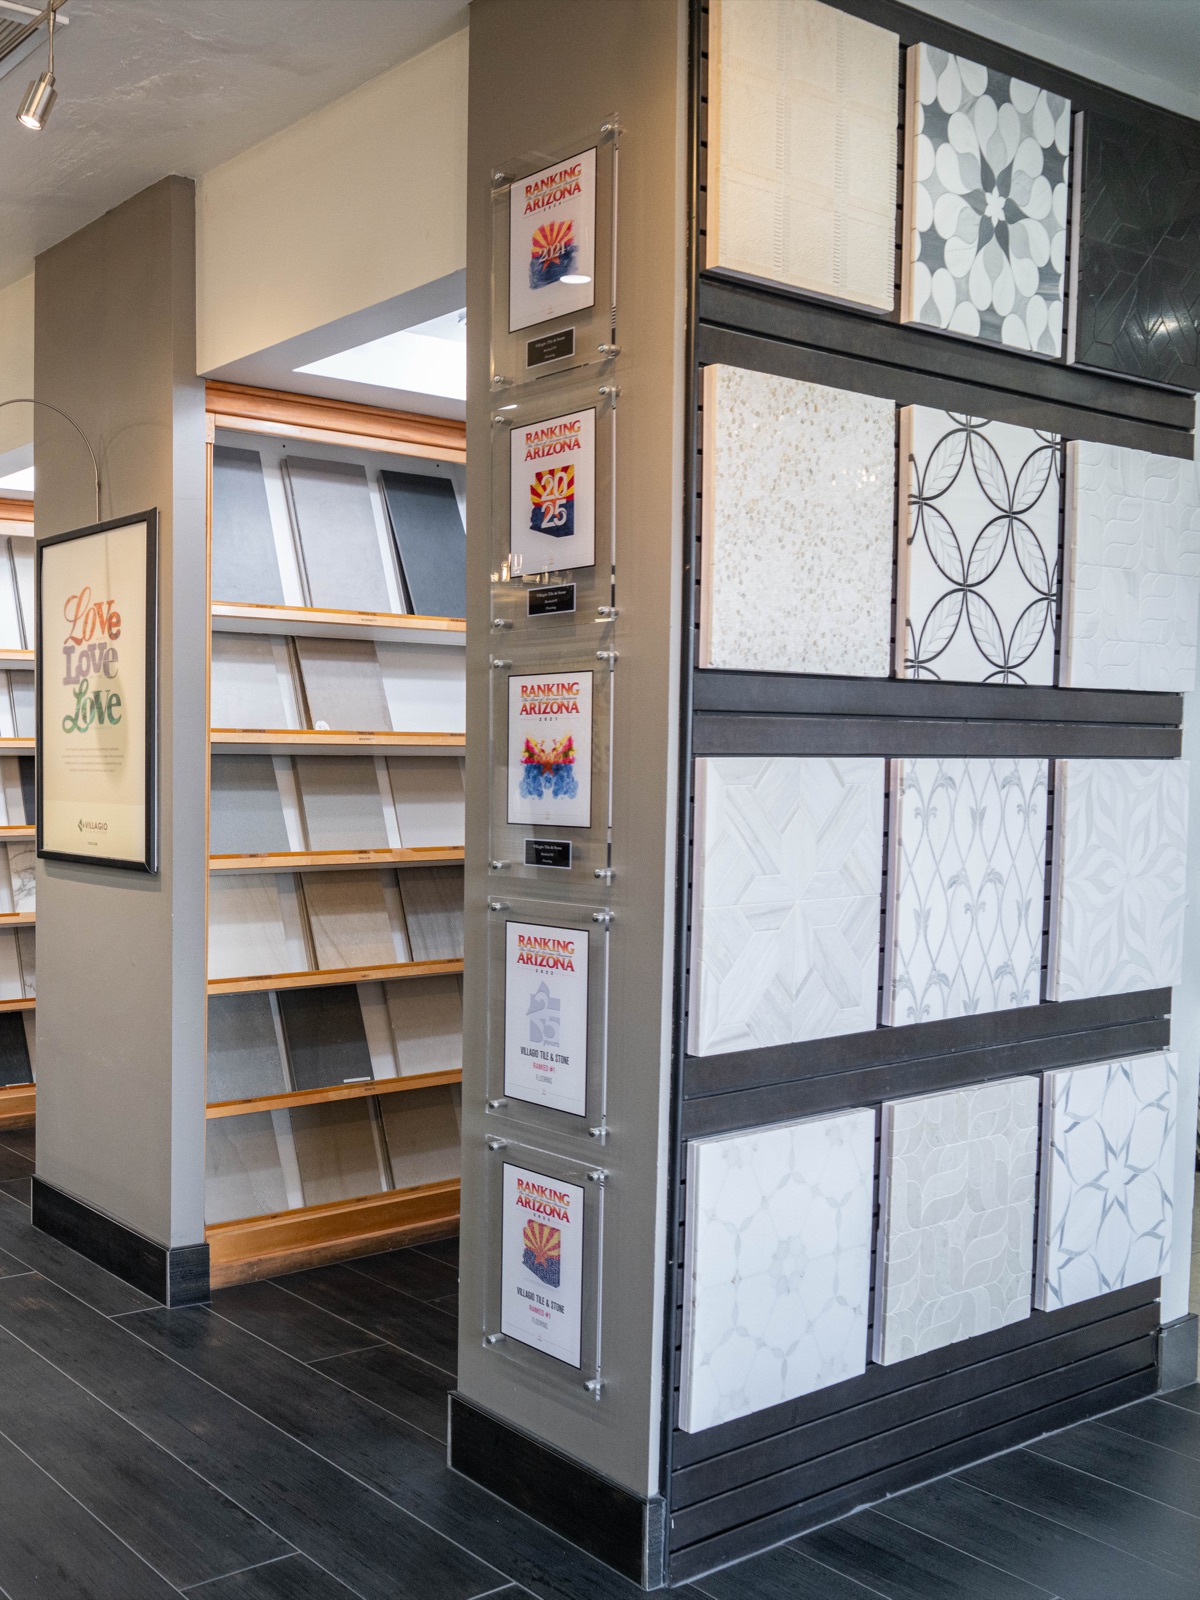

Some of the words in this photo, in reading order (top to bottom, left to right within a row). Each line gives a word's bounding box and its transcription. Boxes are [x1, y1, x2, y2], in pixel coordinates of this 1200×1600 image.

[525, 163, 582, 198] RANKING
[524, 181, 582, 215] ARIZONA
[539, 241, 567, 263] 2024
[525, 420, 581, 445] RANKING
[524, 437, 581, 462] ARIZONA
[541, 471, 568, 502] 20
[541, 499, 567, 529] 25
[520, 682, 580, 698] RANKING
[519, 700, 580, 716] ARIZONA
[84, 821, 108, 831] VILLAGIO
[517, 934, 575, 955] RANKING
[517, 951, 575, 972] ARIZONA
[540, 1050, 549, 1061] TILE
[550, 1053, 554, 1062] &
[555, 1054, 570, 1065] STONE
[517, 1177, 571, 1207] RANKING
[516, 1194, 571, 1223] ARIZONA
[536, 1294, 545, 1306] TILE
[545, 1299, 550, 1308] &
